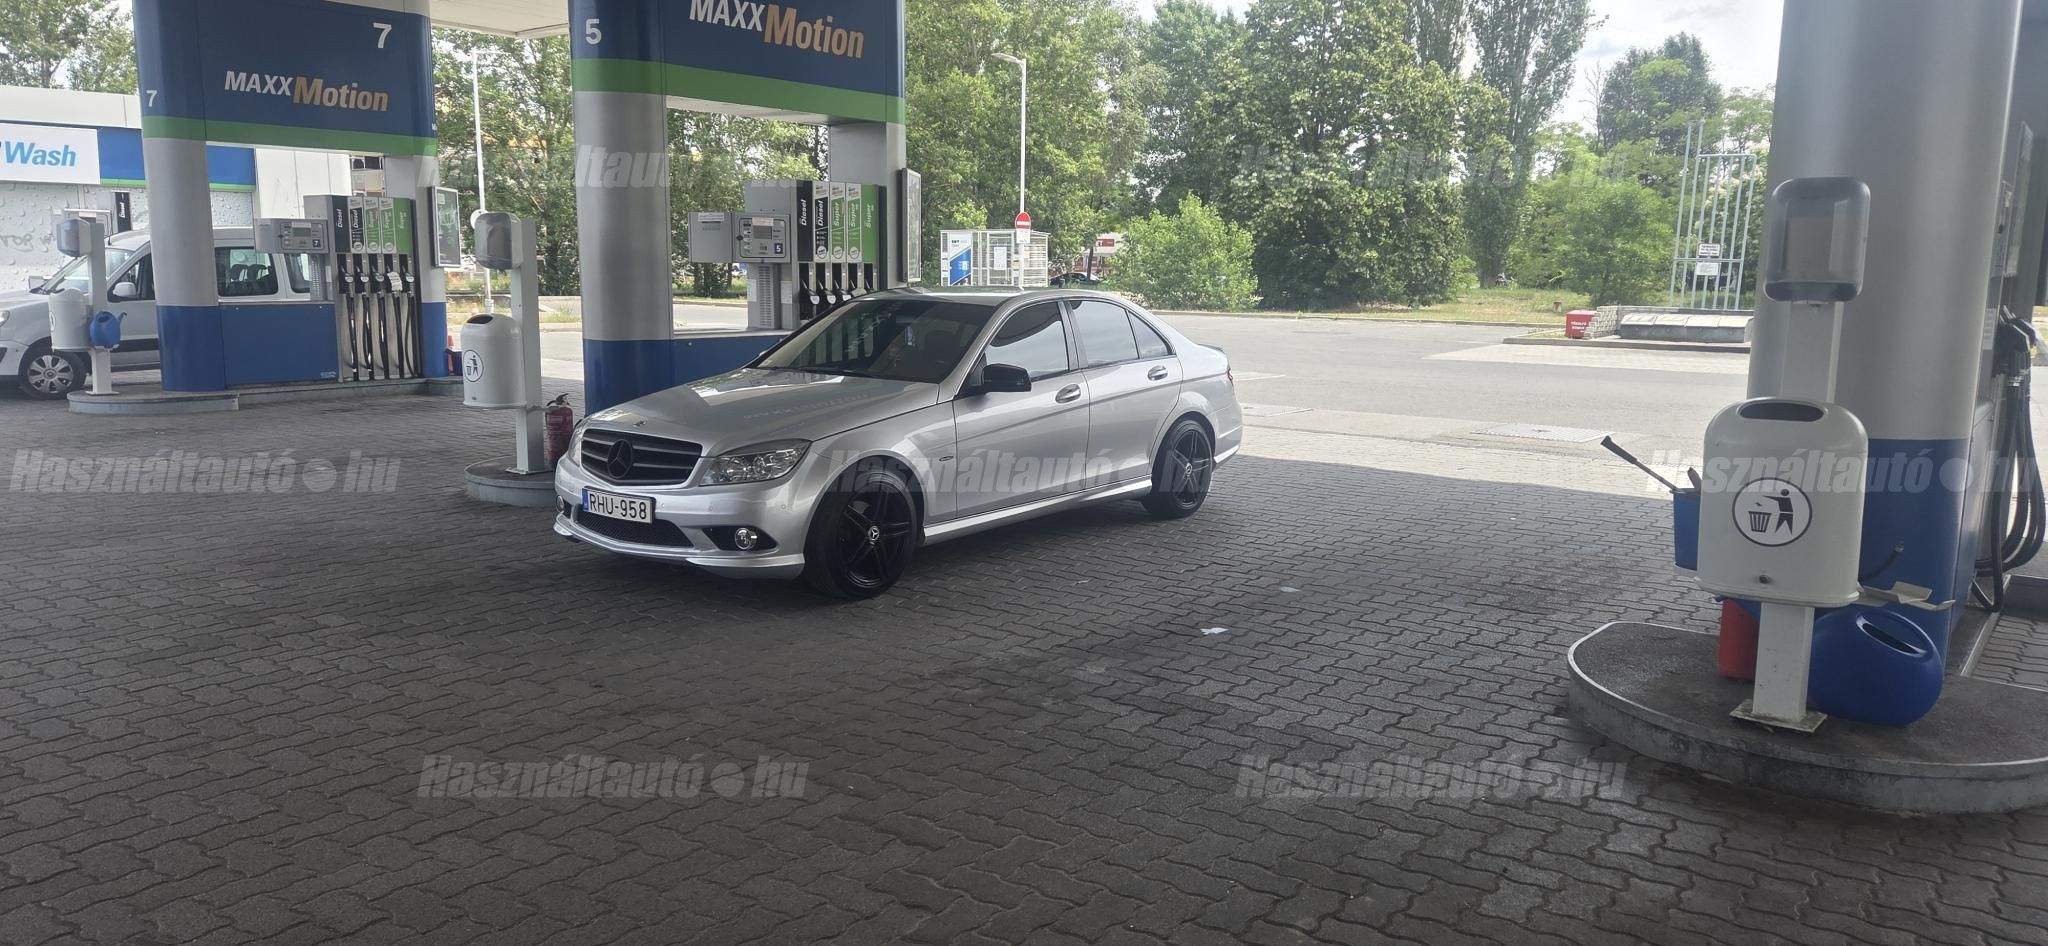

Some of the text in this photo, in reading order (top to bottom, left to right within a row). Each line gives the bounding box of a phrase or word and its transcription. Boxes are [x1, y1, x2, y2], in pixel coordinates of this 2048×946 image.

[373, 22, 392, 49] 7
[585, 18, 602, 44] 5
[146, 89, 158, 108] 7
[4, 140, 77, 167] Wash
[776, 244, 782, 252] 5
[589, 493, 647, 519] RHU-958
